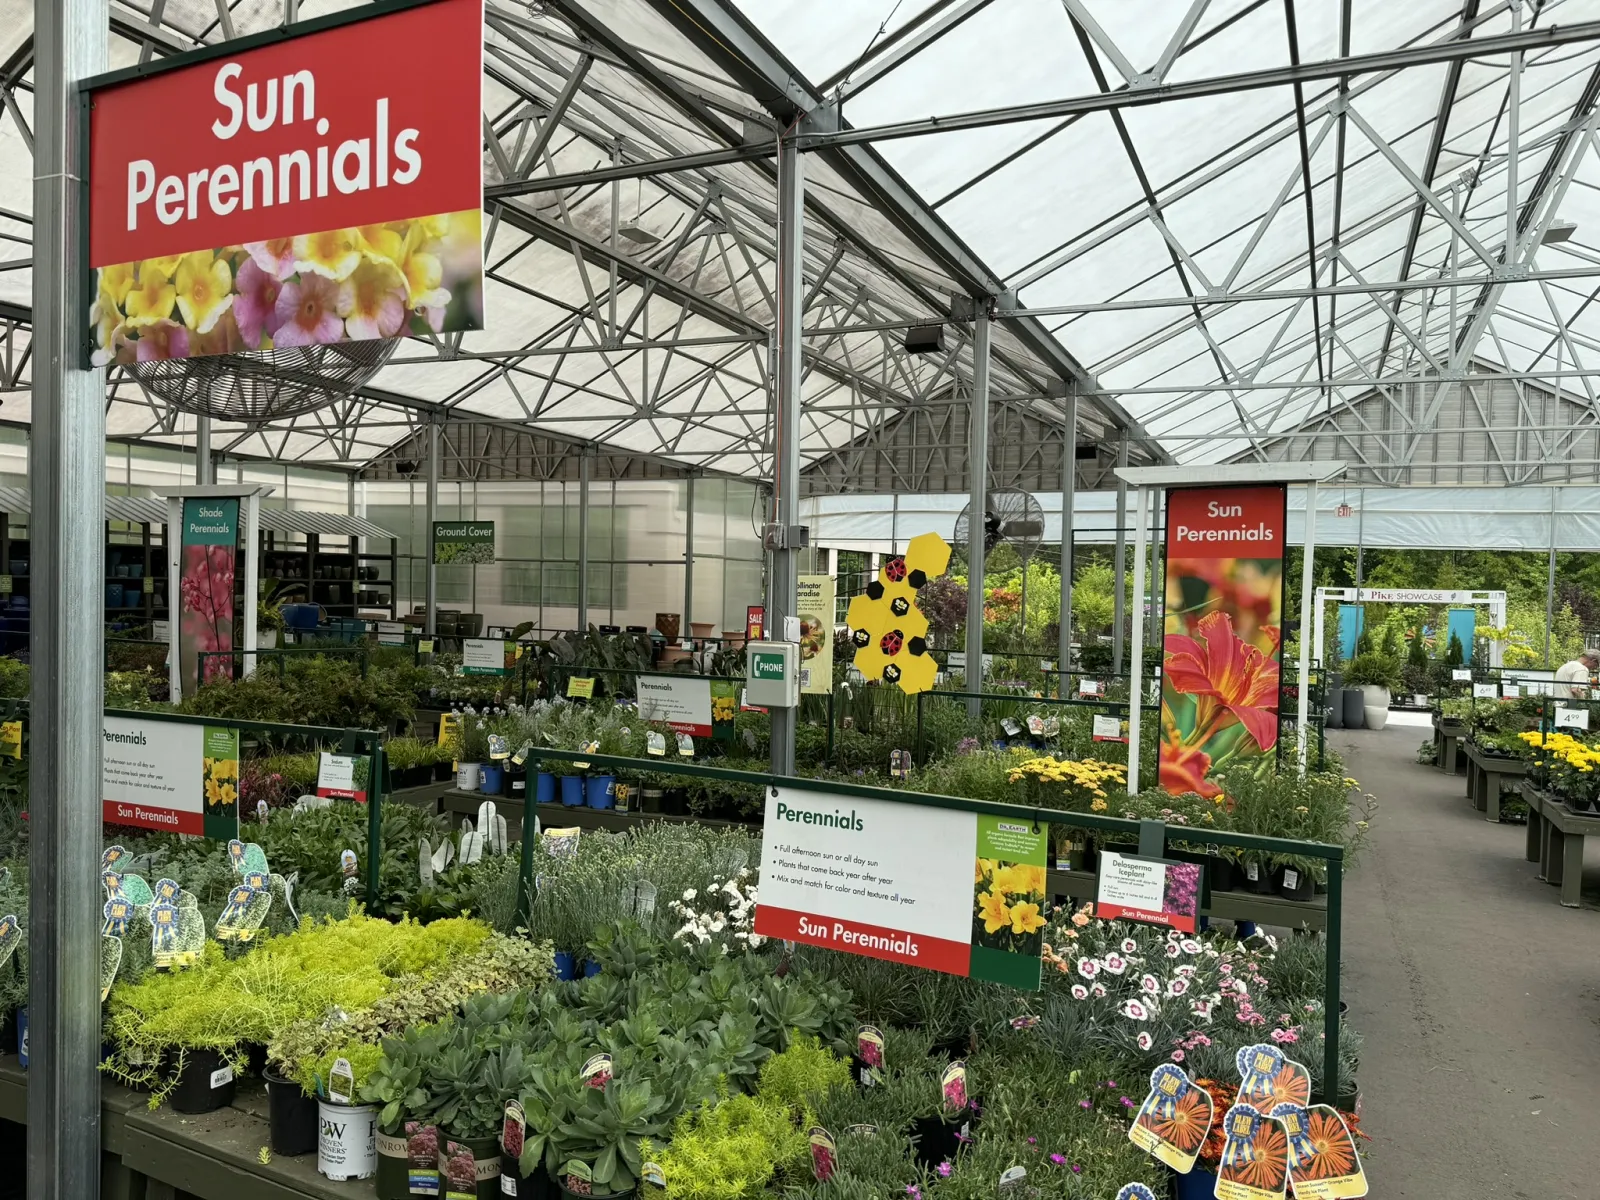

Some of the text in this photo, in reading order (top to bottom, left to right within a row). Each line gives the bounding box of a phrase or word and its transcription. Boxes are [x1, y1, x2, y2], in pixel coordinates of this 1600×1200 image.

[211, 62, 315, 140] Sun
[127, 97, 422, 231] Perennials
[198, 506, 223, 518] Shade
[1207, 501, 1242, 518] Sun
[190, 522, 230, 534] Perennials
[436, 525, 493, 537] Ground Cover
[1177, 522, 1273, 542] Perennials
[1397, 592, 1443, 601] SHOWCASE
[749, 614, 762, 624] SALE
[760, 663, 783, 672] PHONE
[641, 682, 673, 692] Perennials
[103, 729, 147, 746] Perennials
[117, 804, 179, 825] Sun Perennials
[777, 802, 863, 831] Perennials
[779, 845, 790, 854] Full
[792, 846, 822, 858] afternoon
[853, 856, 866, 867] day
[778, 859, 894, 885] Plants that come back year after year
[1112, 859, 1152, 872] Delosperma
[1119, 868, 1145, 878] Iceplant
[776, 874, 916, 905] Mix and match for color and texture all year
[1122, 908, 1168, 923] Sun Perennial
[798, 916, 918, 957] Sun Perennials
[320, 1116, 347, 1140] PW
